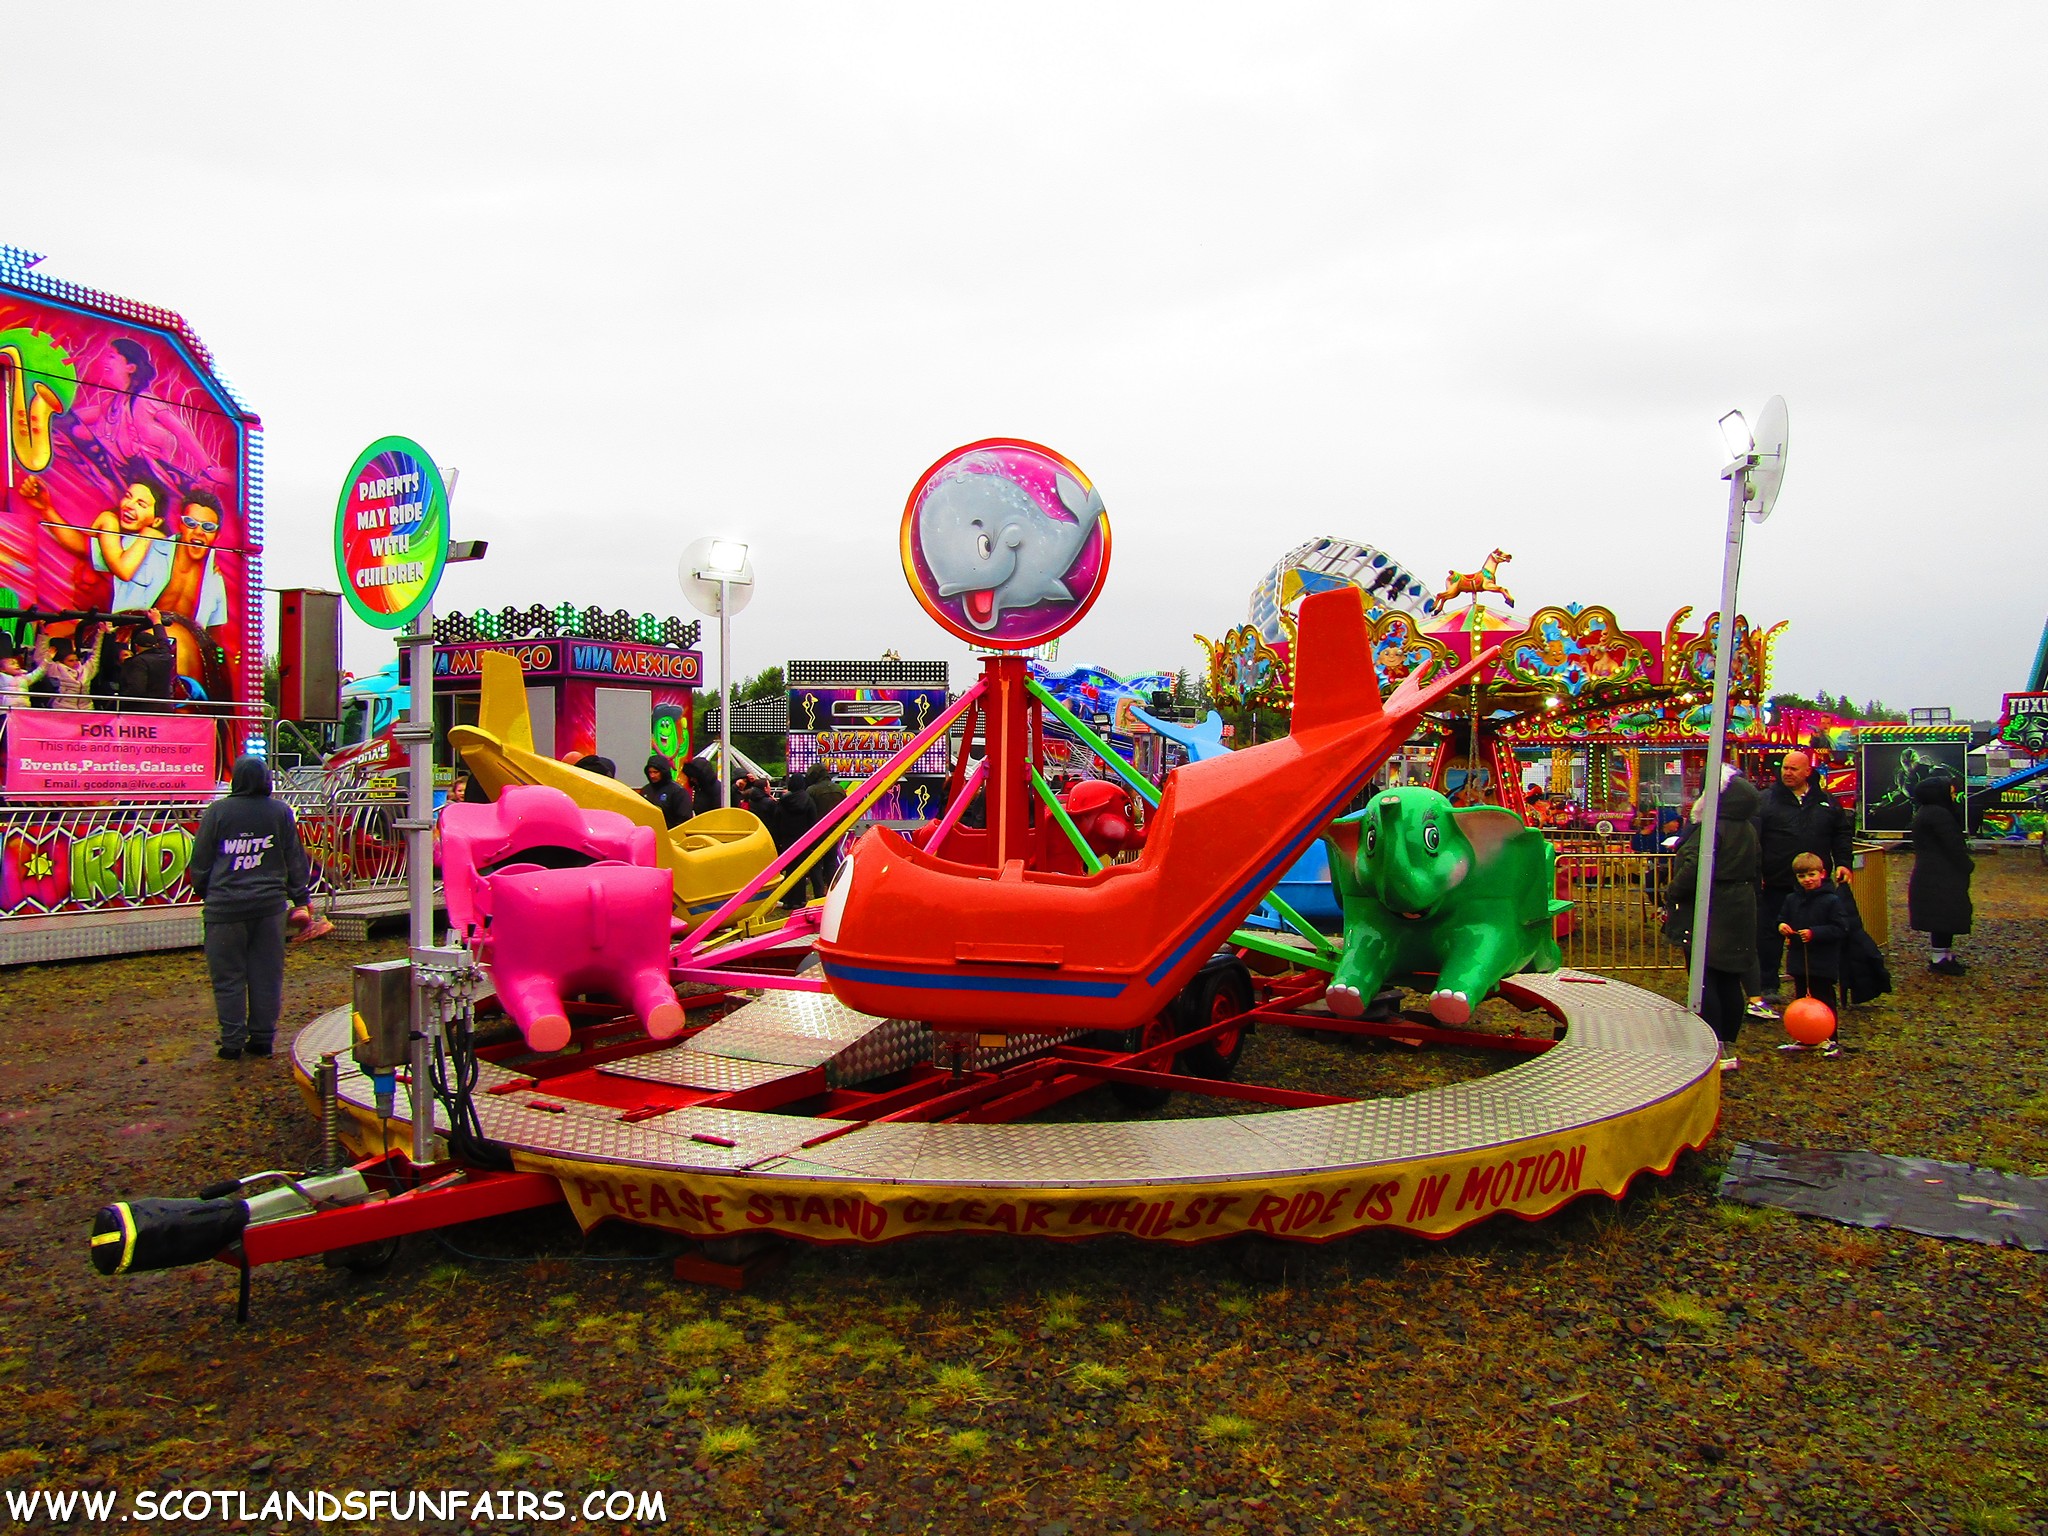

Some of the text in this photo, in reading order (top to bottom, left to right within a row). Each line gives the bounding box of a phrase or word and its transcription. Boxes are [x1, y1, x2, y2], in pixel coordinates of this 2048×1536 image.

[359, 472, 419, 501] PARENTS
[357, 502, 422, 530] MAY RIDE
[370, 534, 410, 557] WITH
[356, 562, 424, 588] CHILDREN
[451, 645, 552, 675] MECO
[574, 646, 697, 679] VIVA MEXICO
[80, 724, 157, 739] FOR HIRE
[39, 741, 192, 755] This ride and many others for
[20, 758, 204, 774] Events,Parties,Galas etc
[44, 778, 186, 790] Email. gcodona@live.co.uk
[224, 834, 274, 854] WHITE
[234, 852, 264, 871] FOX
[574, 1144, 1587, 1241] PLEASE STAND CLEAR WHILST RIDE IS IN MOTION
